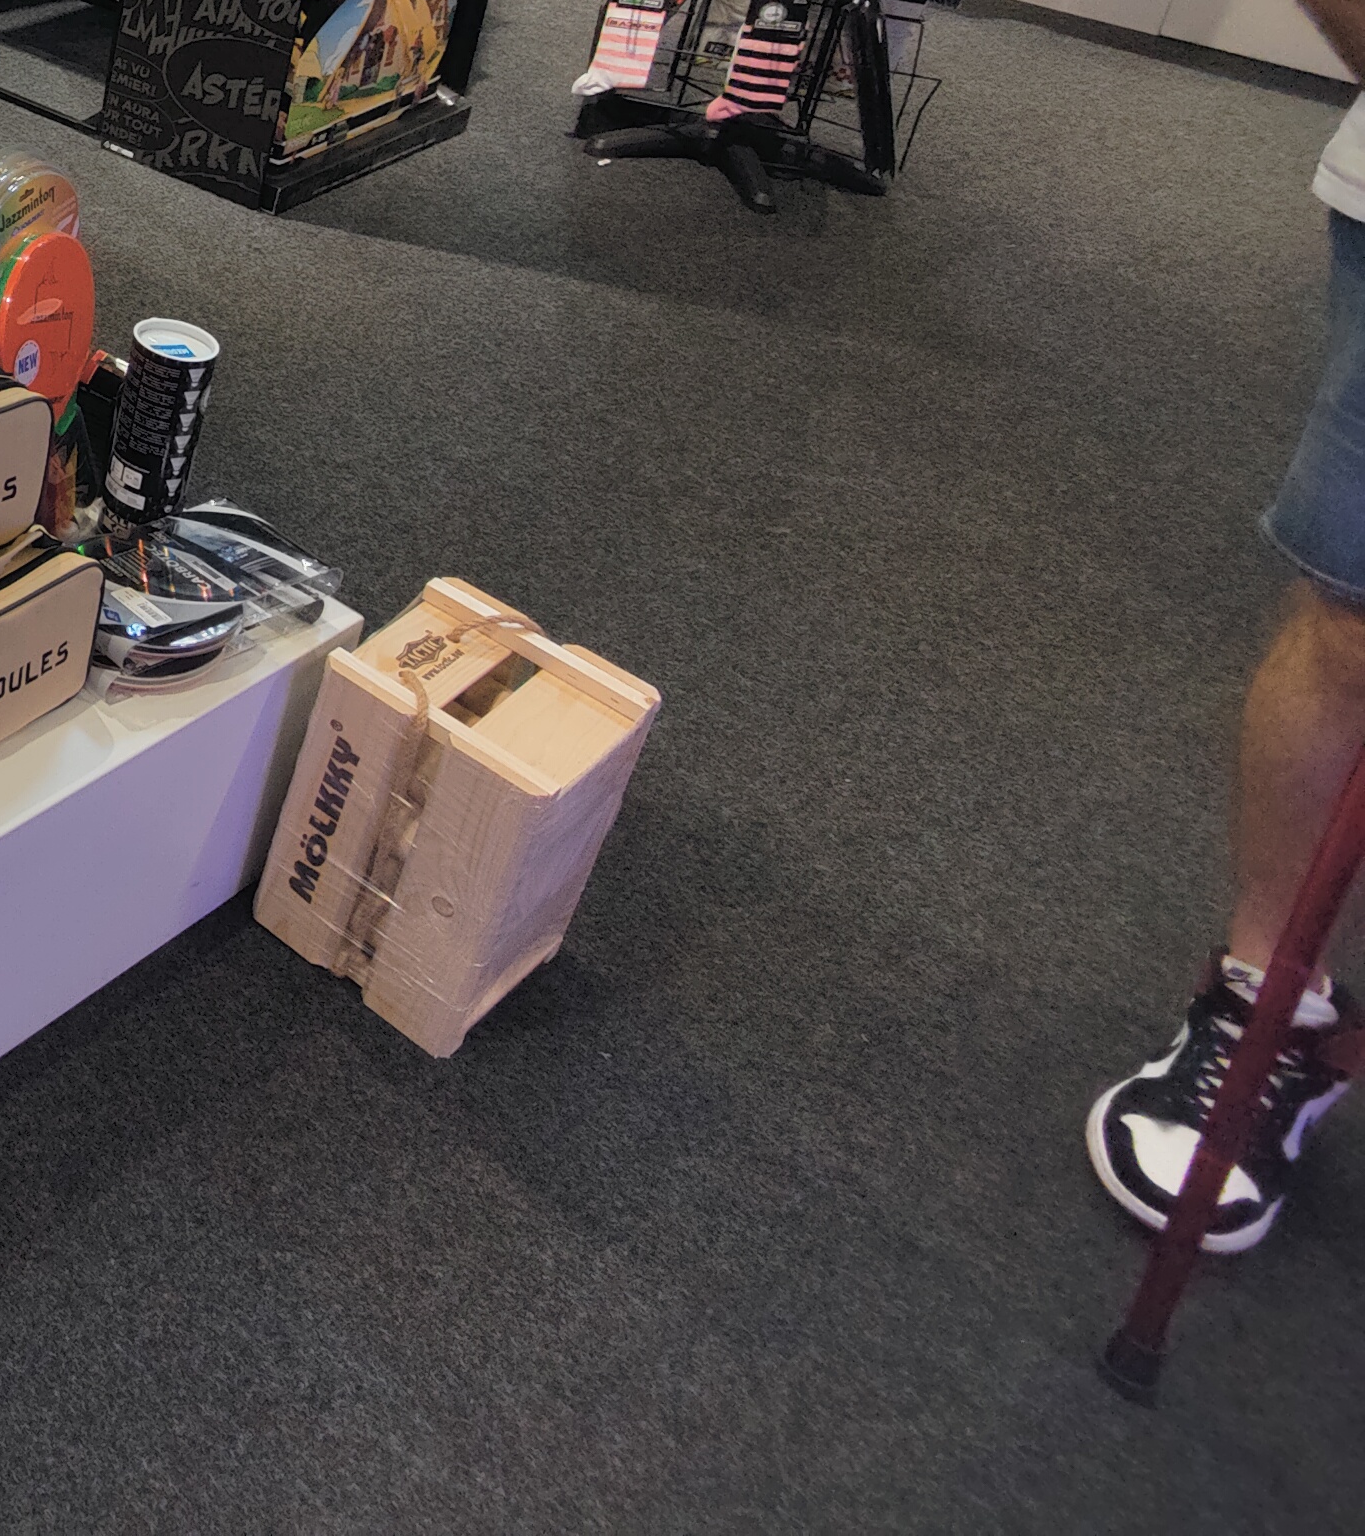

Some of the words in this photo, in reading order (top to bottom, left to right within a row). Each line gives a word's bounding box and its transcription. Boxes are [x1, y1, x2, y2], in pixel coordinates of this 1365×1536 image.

[17, 354, 39, 375] NEW
[400, 635, 445, 670] TACTIC
[289, 735, 361, 905] MÖLKKY
